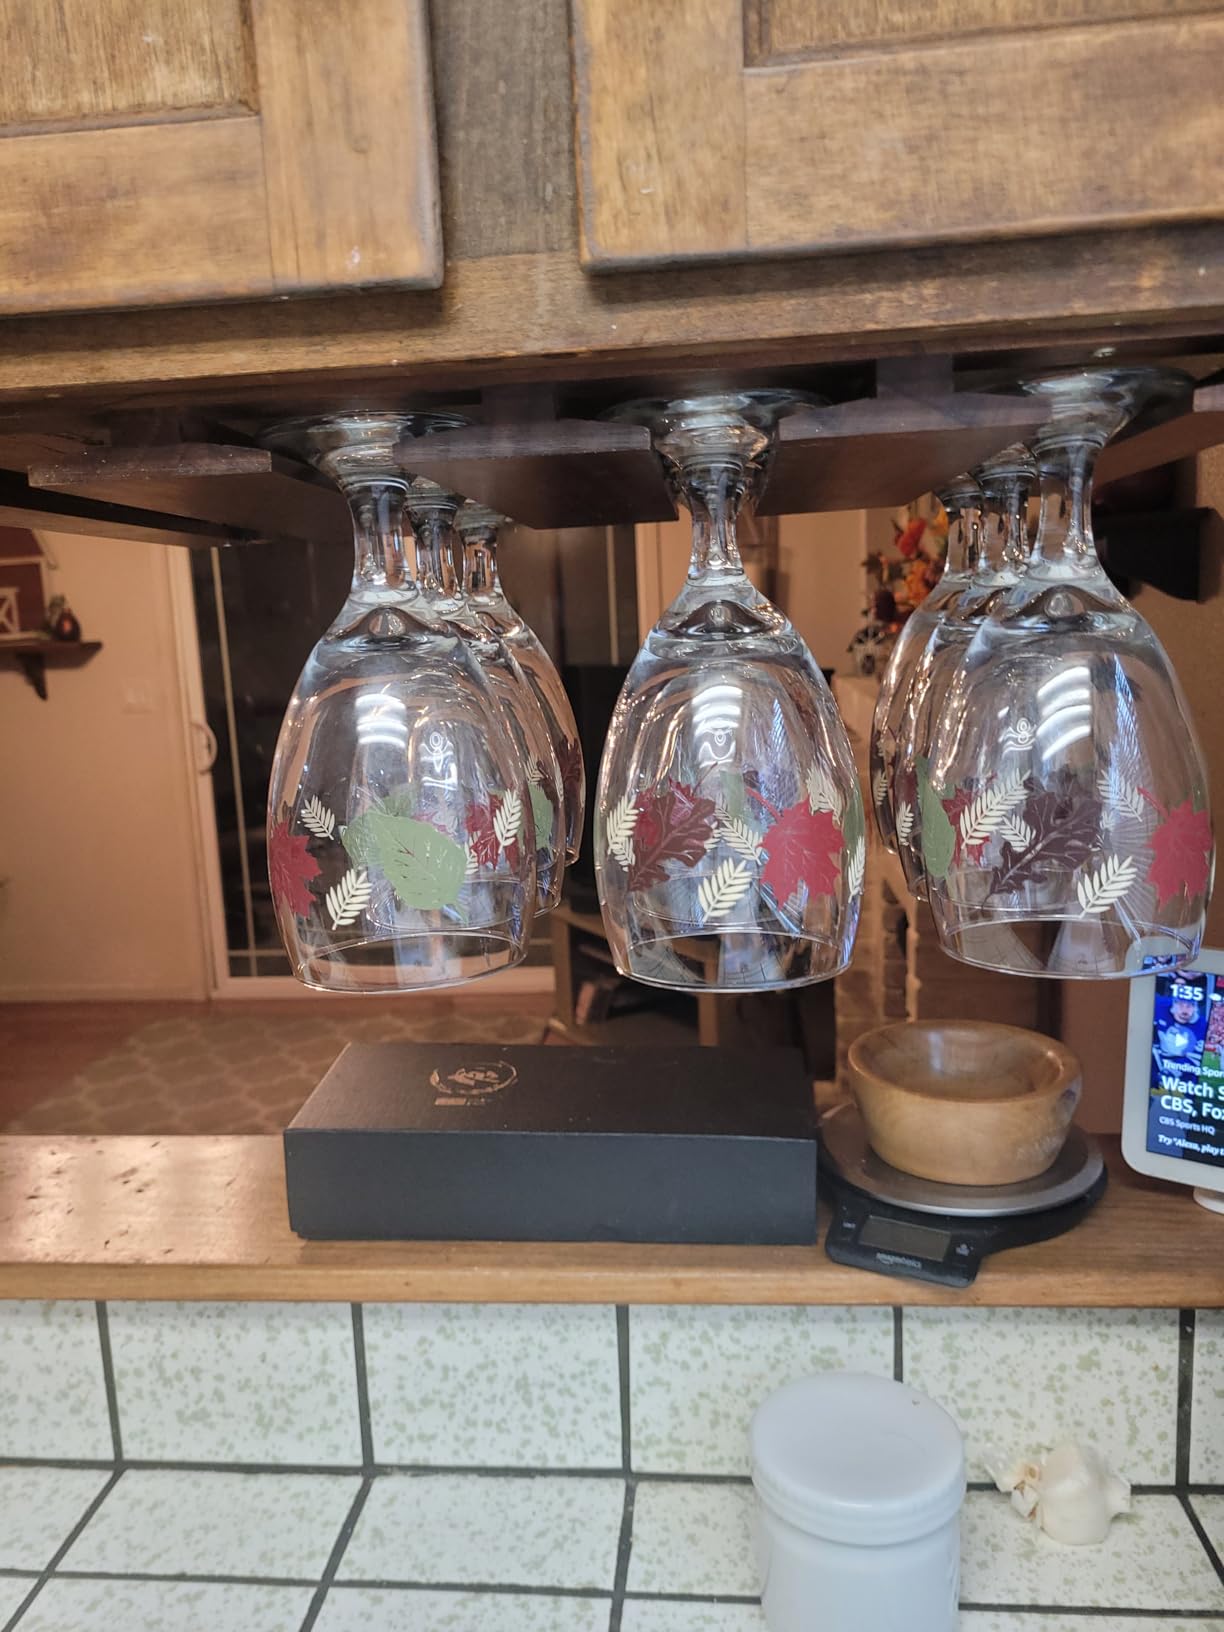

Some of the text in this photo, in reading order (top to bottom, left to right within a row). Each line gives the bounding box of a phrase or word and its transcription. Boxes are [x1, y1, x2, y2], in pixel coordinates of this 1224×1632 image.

[1170, 984, 1204, 1001] 1:35
[1162, 1059, 1200, 1076] Trending
[1161, 1075, 1214, 1098] Watch
[1160, 1095, 1198, 1117] CBS,
[1159, 1116, 1216, 1136] CBS Sports HQ
[1158, 1134, 1173, 1146] Try
